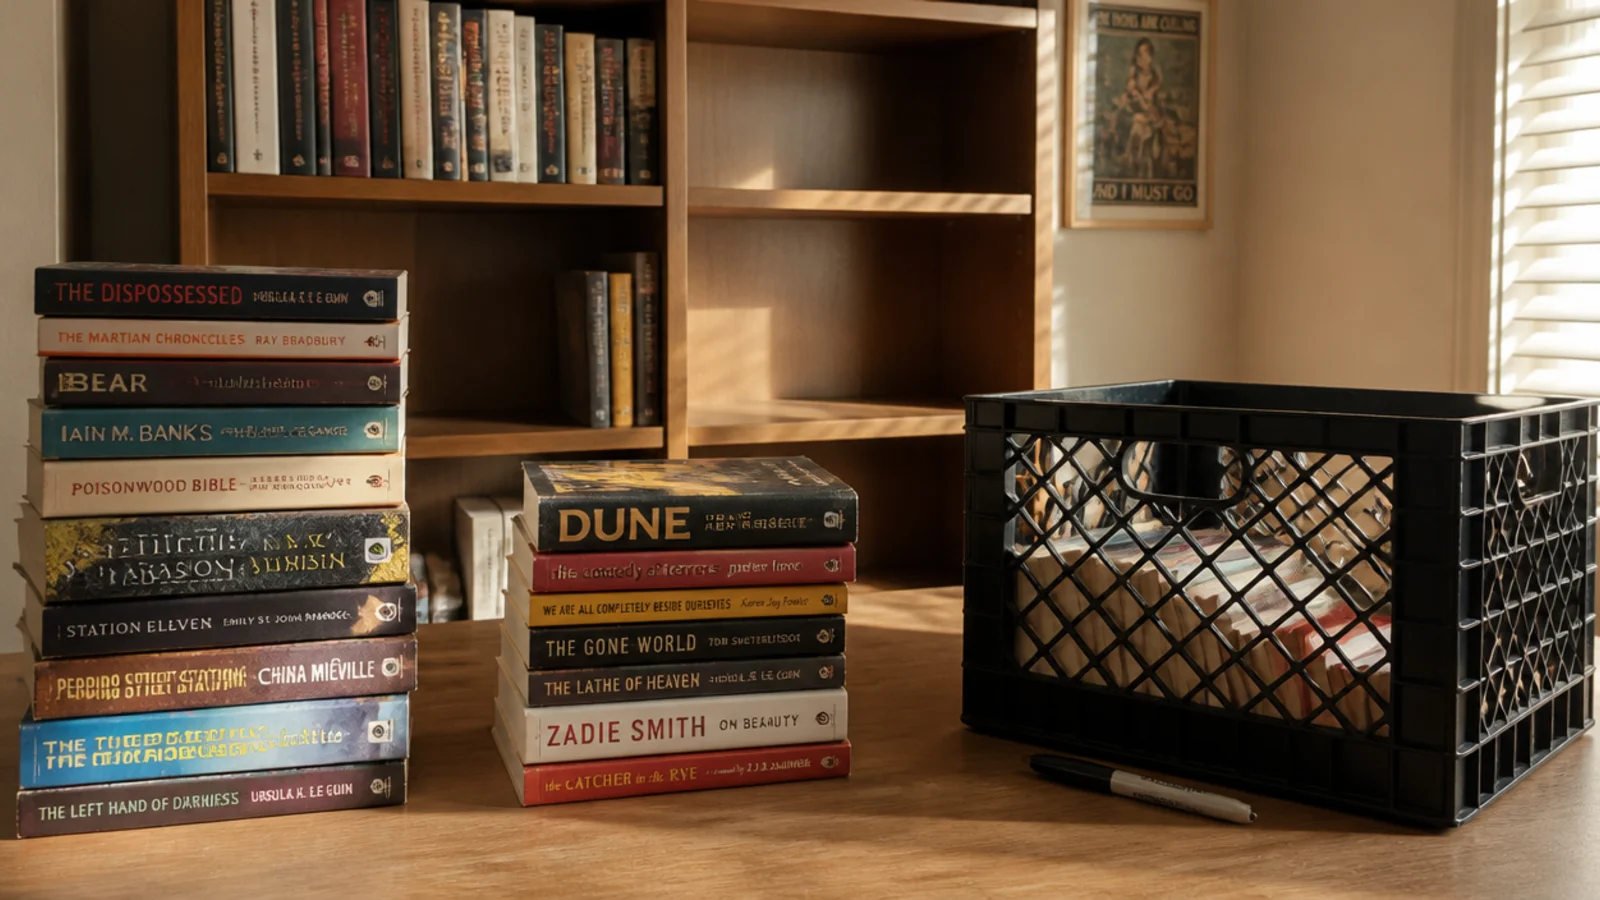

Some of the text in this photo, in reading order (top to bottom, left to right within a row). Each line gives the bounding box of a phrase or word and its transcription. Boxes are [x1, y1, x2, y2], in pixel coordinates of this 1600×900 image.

[1122, 184, 1127, 199] I
[1132, 184, 1169, 200] MUST
[1172, 185, 1193, 201] GO
[55, 282, 94, 301] THE
[101, 283, 242, 305] DISPOSSESSED
[58, 332, 83, 343] THE
[88, 332, 151, 344] MARTIAN
[256, 335, 277, 345] RAY
[61, 425, 106, 442] IAIN
[139, 424, 213, 442] BANKS
[71, 480, 187, 496] POISONWOOD
[192, 478, 236, 492] BIBLE
[558, 506, 691, 542] DUNE
[543, 606, 556, 616] WE
[559, 604, 575, 615] ARE
[578, 604, 594, 615] ALL
[66, 621, 141, 638] STATION
[545, 640, 576, 657] THE
[584, 637, 629, 656] GONE
[637, 633, 697, 653] WORLD
[258, 664, 306, 685] CHINA
[544, 681, 571, 696] THE
[576, 678, 621, 695] LATHE
[625, 676, 644, 692] OF
[646, 672, 700, 690] HEAVEN
[547, 721, 621, 747] ZADIE
[631, 715, 705, 742] SMITH
[719, 719, 737, 731] ON
[565, 772, 632, 791] CATCHER
[669, 766, 697, 782] RYE
[38, 806, 66, 821] THE
[70, 802, 104, 818] LEFT
[108, 799, 147, 816] HAND
[151, 797, 169, 812] OF
